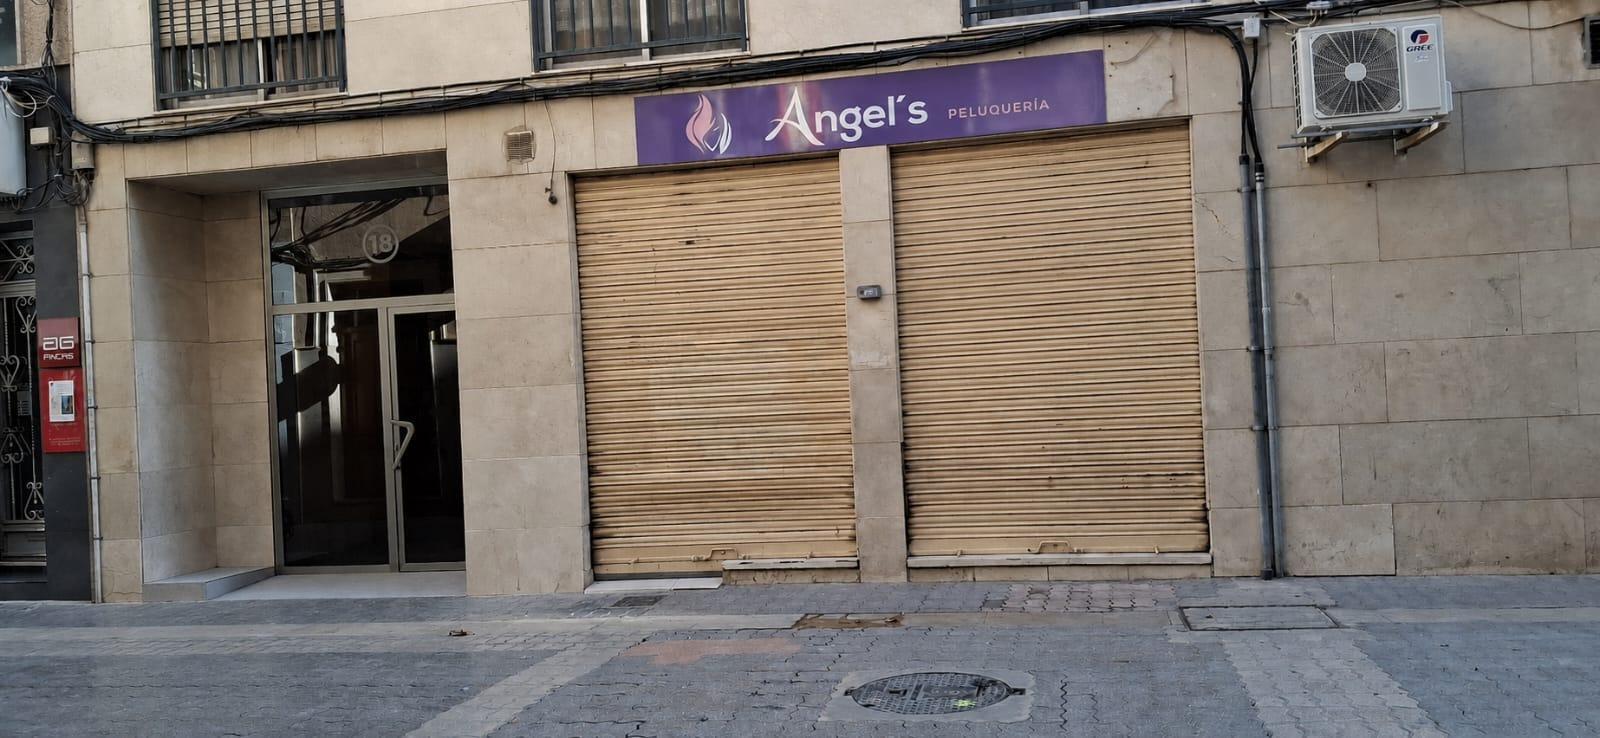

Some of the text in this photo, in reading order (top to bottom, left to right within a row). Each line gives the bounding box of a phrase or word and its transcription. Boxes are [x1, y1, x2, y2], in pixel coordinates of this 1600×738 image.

[1406, 44, 1433, 52] GREE
[948, 97, 1050, 120] PELUQUERÍA
[368, 234, 393, 255] 18
[43, 352, 74, 361] FINCAS
